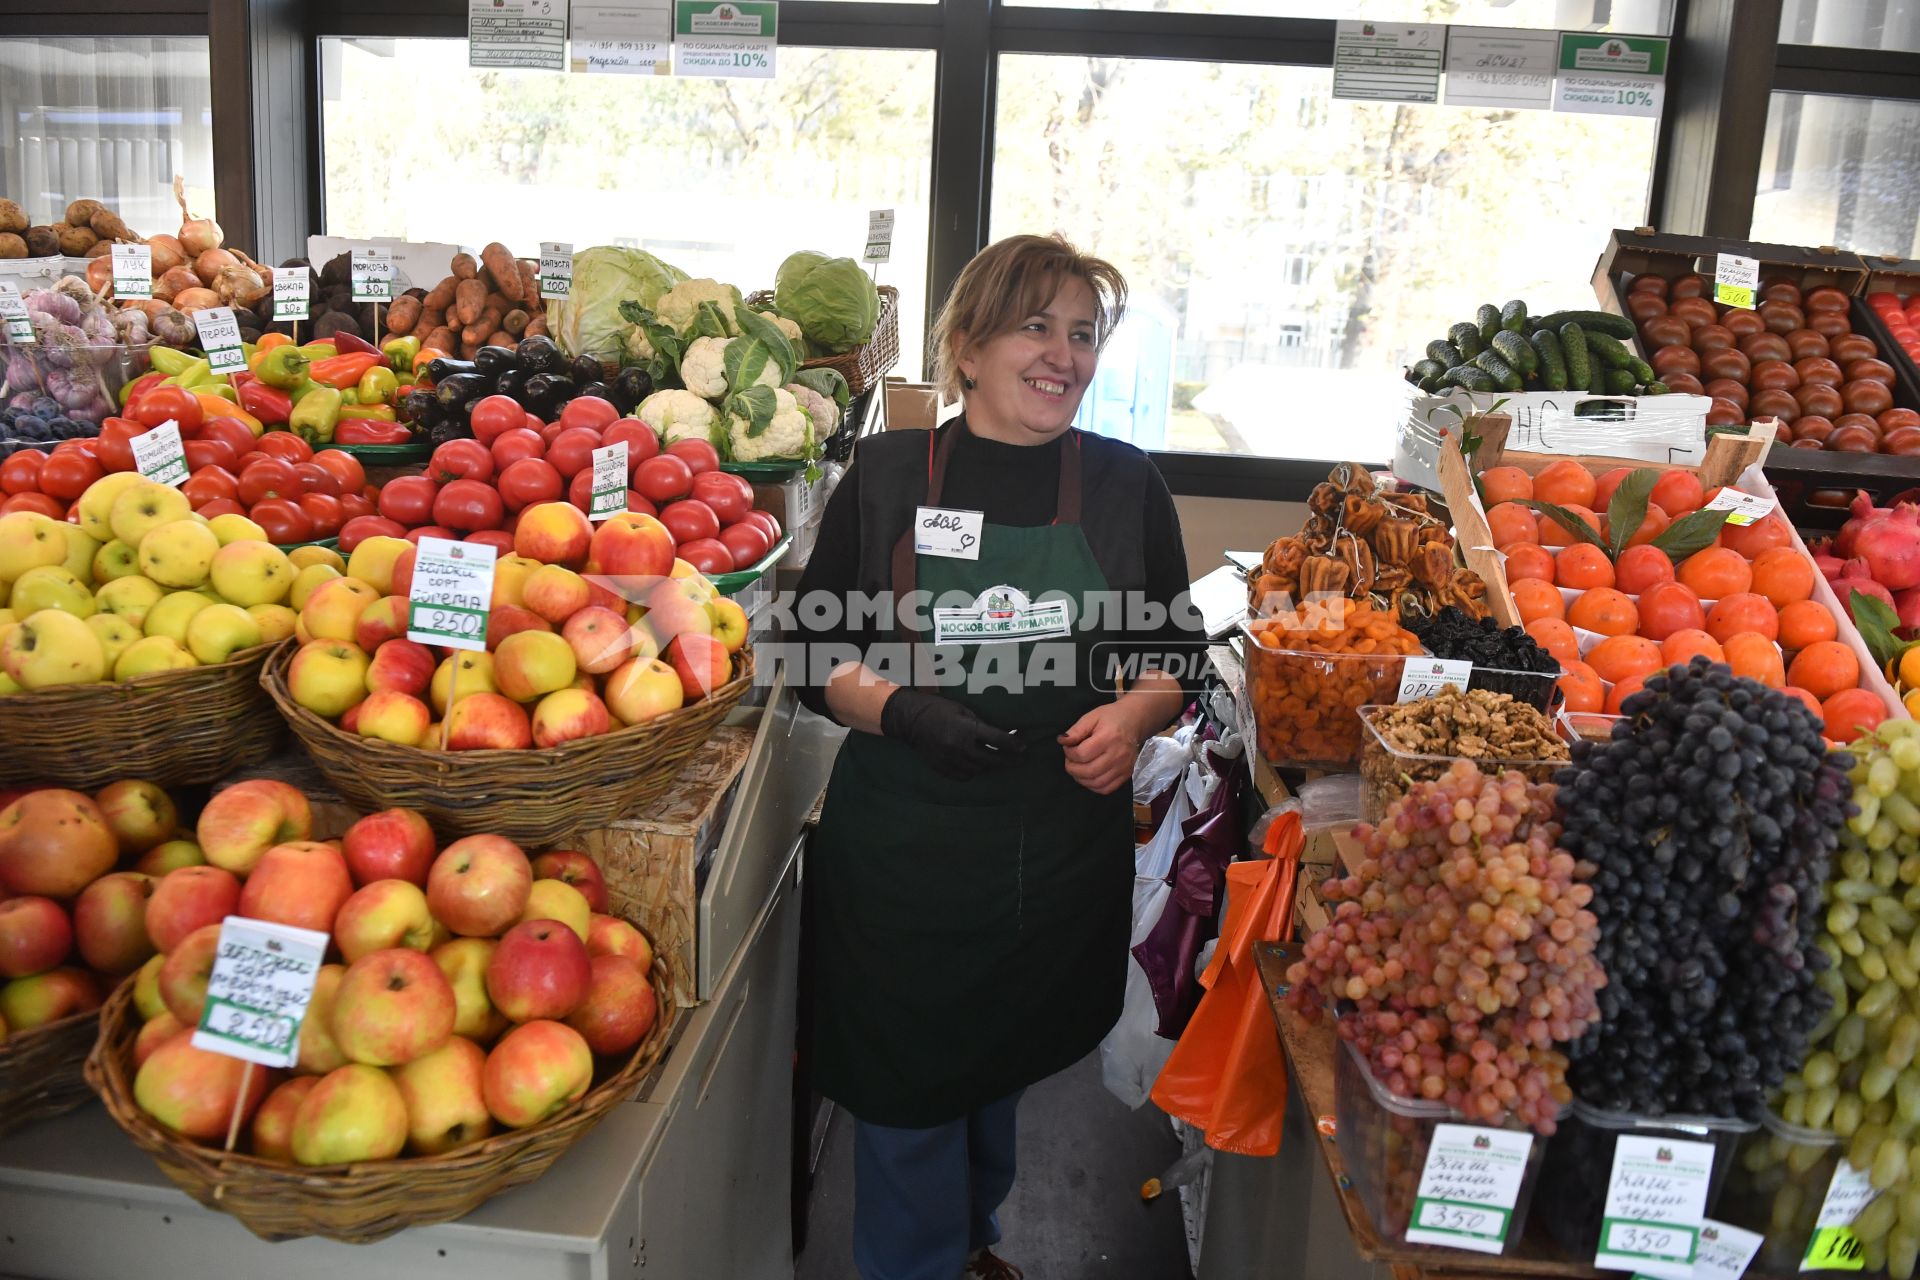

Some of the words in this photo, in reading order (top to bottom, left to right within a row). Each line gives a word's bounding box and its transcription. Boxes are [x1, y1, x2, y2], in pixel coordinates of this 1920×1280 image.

[695, 42, 745, 50] СОЦИАЛЬНОЙ
[683, 58, 717, 66] СКИДКА
[733, 53, 768, 67] 10%
[1578, 78, 1632, 88] СОЦИАЛЬНОЙ
[1633, 82, 1655, 90] КАРТЕ
[1563, 94, 1600, 102] СКИДКА
[1617, 90, 1652, 106] 10%
[941, 622, 1010, 632] МОСКОВСКИЕ
[1017, 616, 1064, 630] ЯРМАРКИ
[1404, 684, 1440, 696] ОРЕ
[1430, 1206, 1486, 1229] 350
[1621, 1228, 1671, 1250] 350
